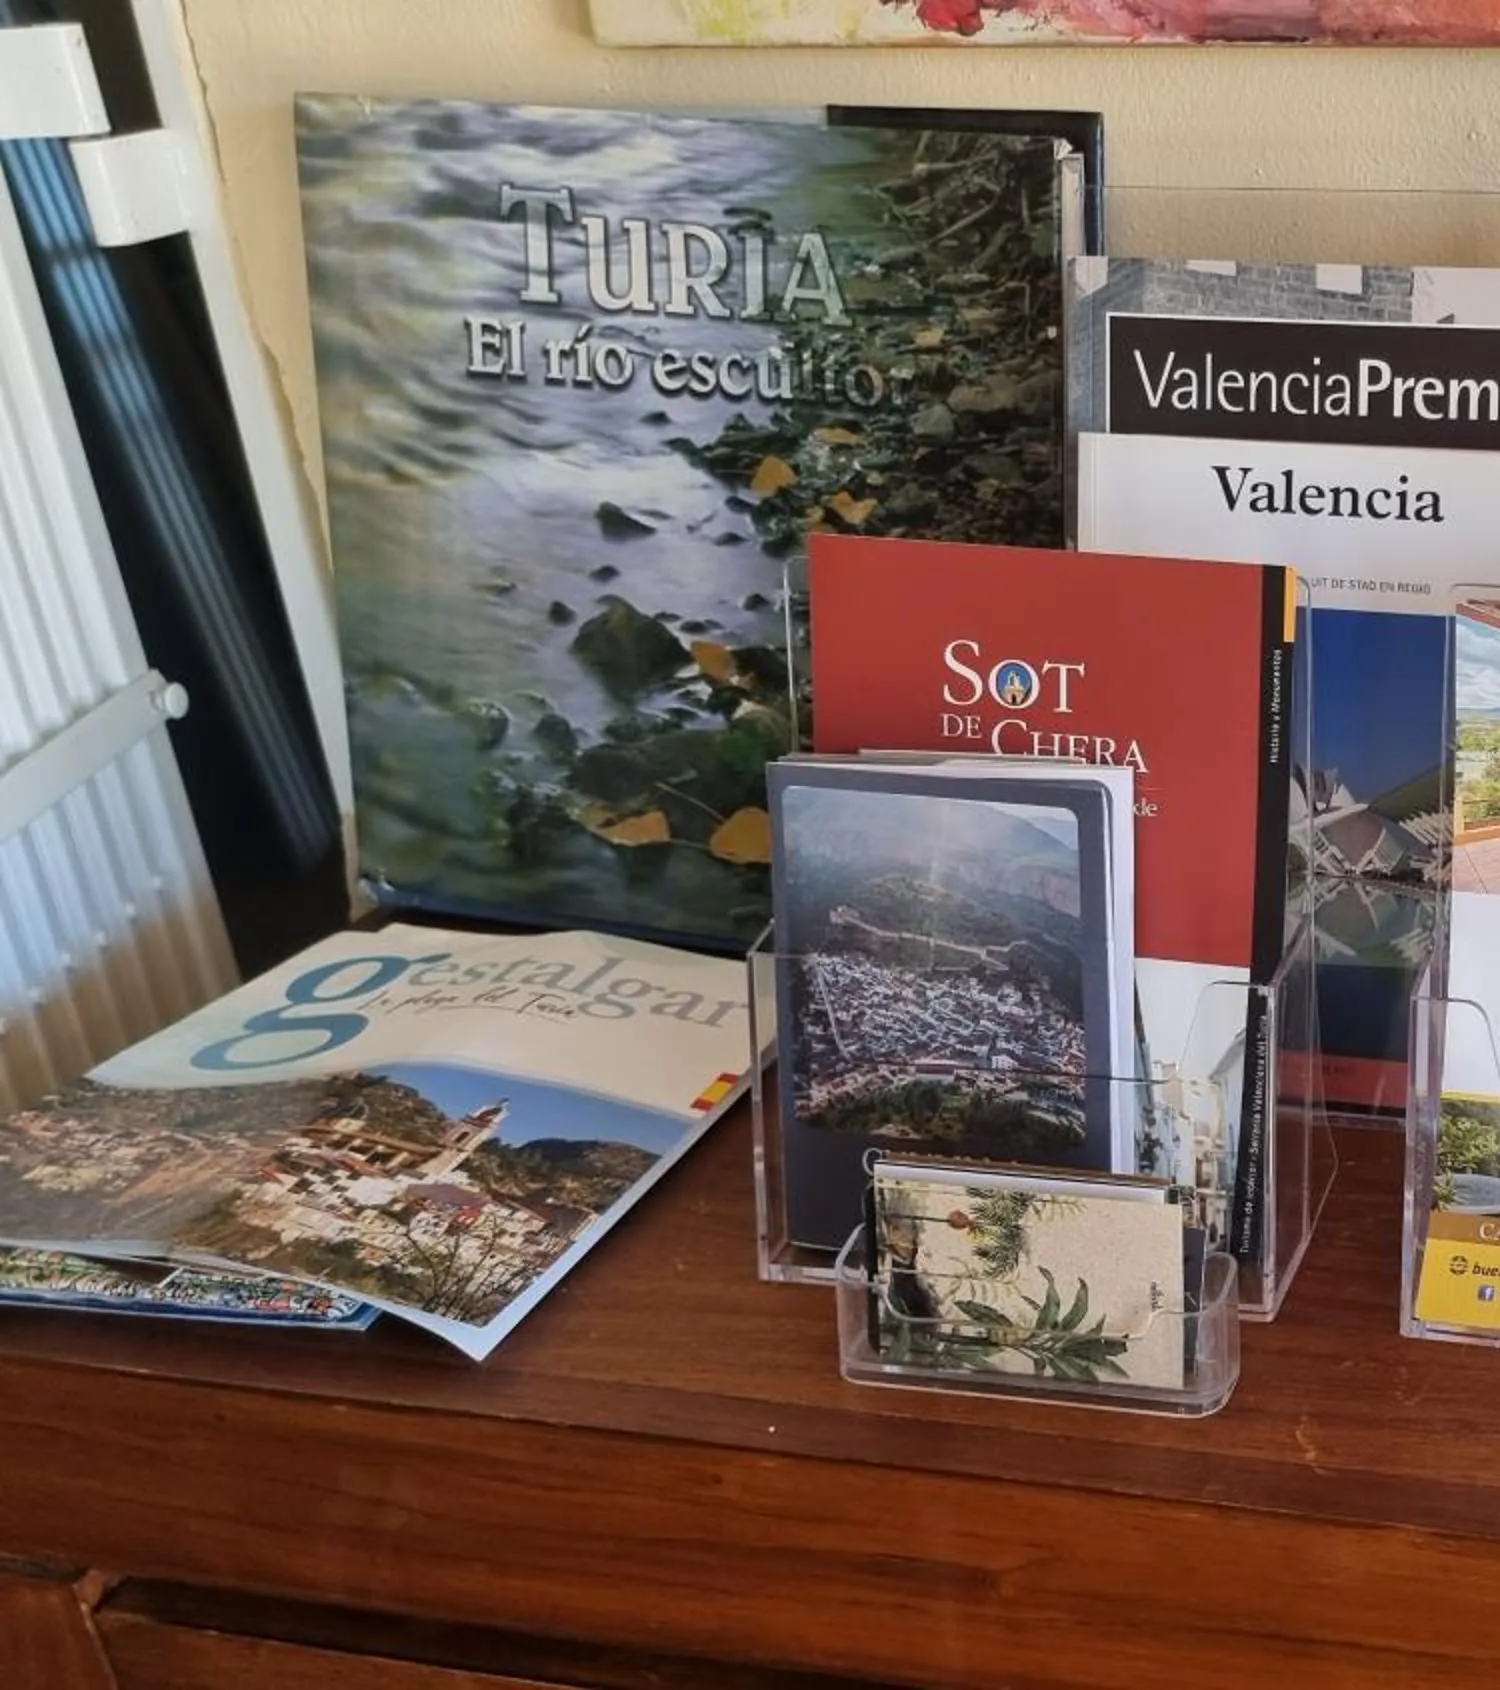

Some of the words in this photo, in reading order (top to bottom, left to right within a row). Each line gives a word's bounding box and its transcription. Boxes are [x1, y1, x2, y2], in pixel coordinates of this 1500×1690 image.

[501, 182, 854, 325] TURIA
[464, 316, 525, 376] El
[543, 322, 632, 387] río
[1211, 465, 1445, 524] Valencia
[943, 639, 1086, 714] SOT
[940, 713, 983, 739] DE
[990, 719, 1149, 774] CHERA
[190, 951, 750, 1073] gestalgar
